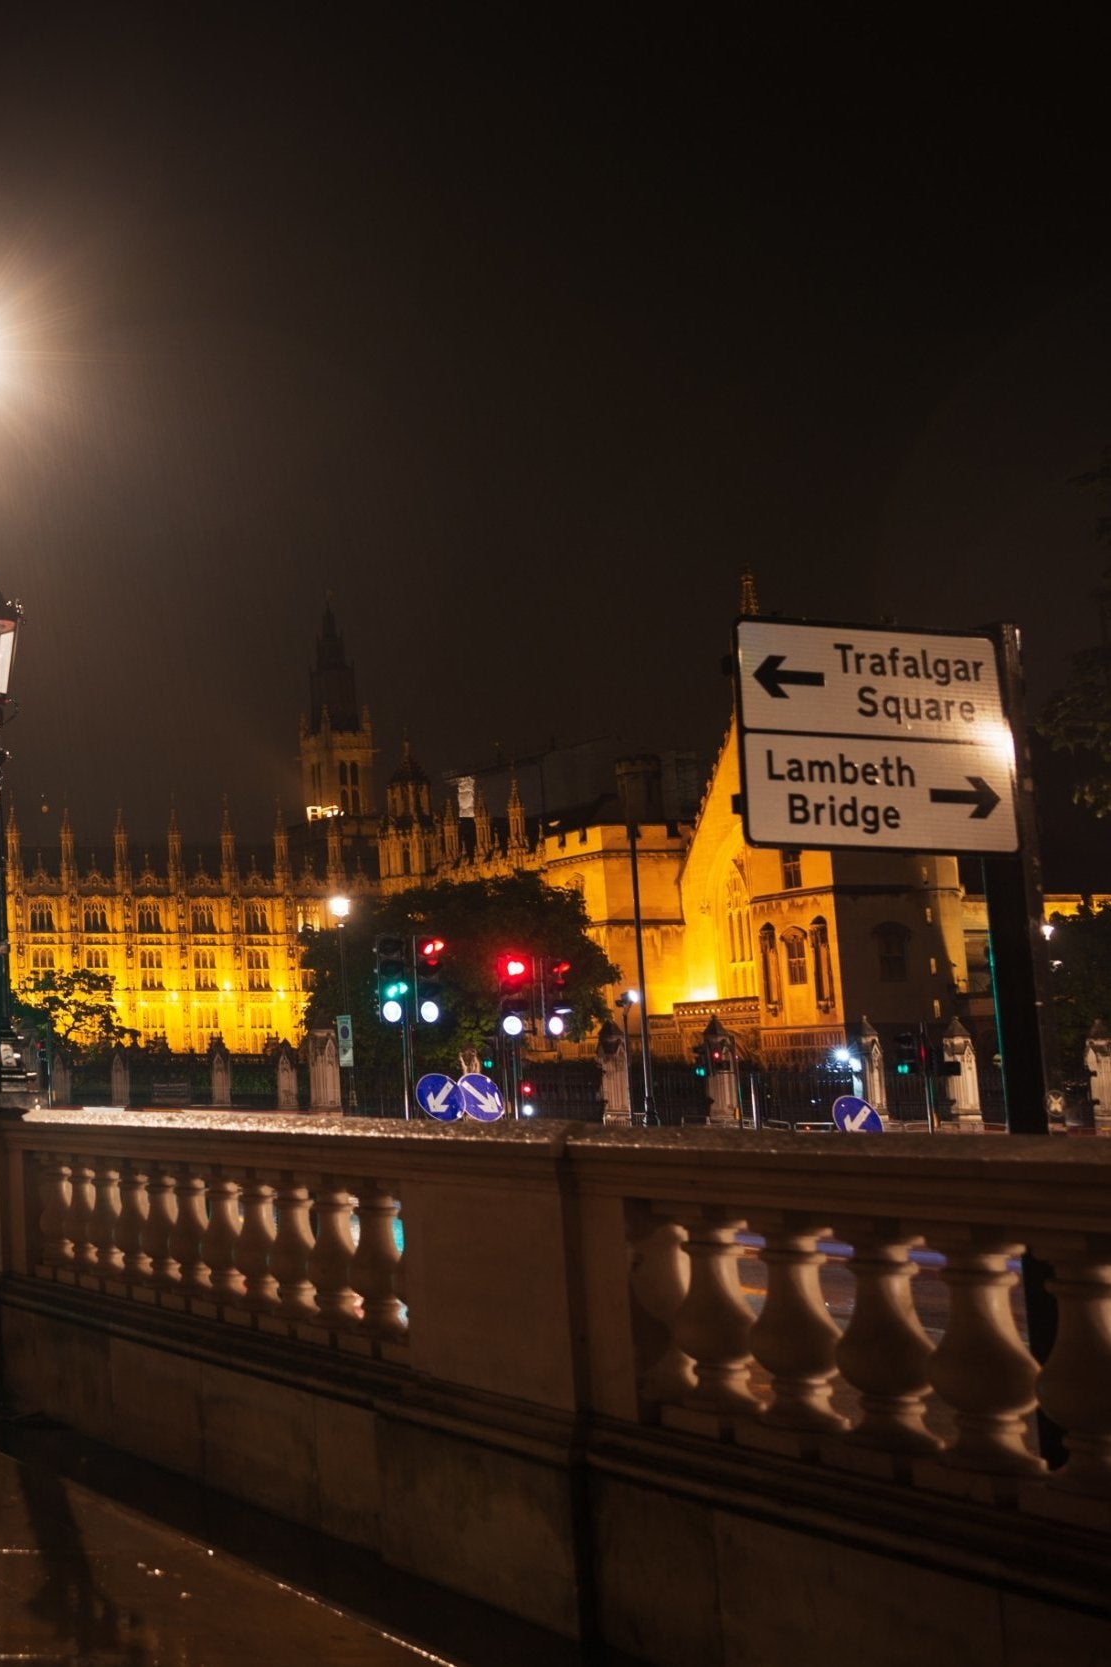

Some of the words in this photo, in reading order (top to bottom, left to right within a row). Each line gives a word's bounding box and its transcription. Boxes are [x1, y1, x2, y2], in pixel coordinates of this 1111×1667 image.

[834, 643, 984, 686] Trafalgar
[857, 687, 976, 724] Square
[766, 750, 916, 787] Lambeth
[788, 793, 901, 834] Bridge
